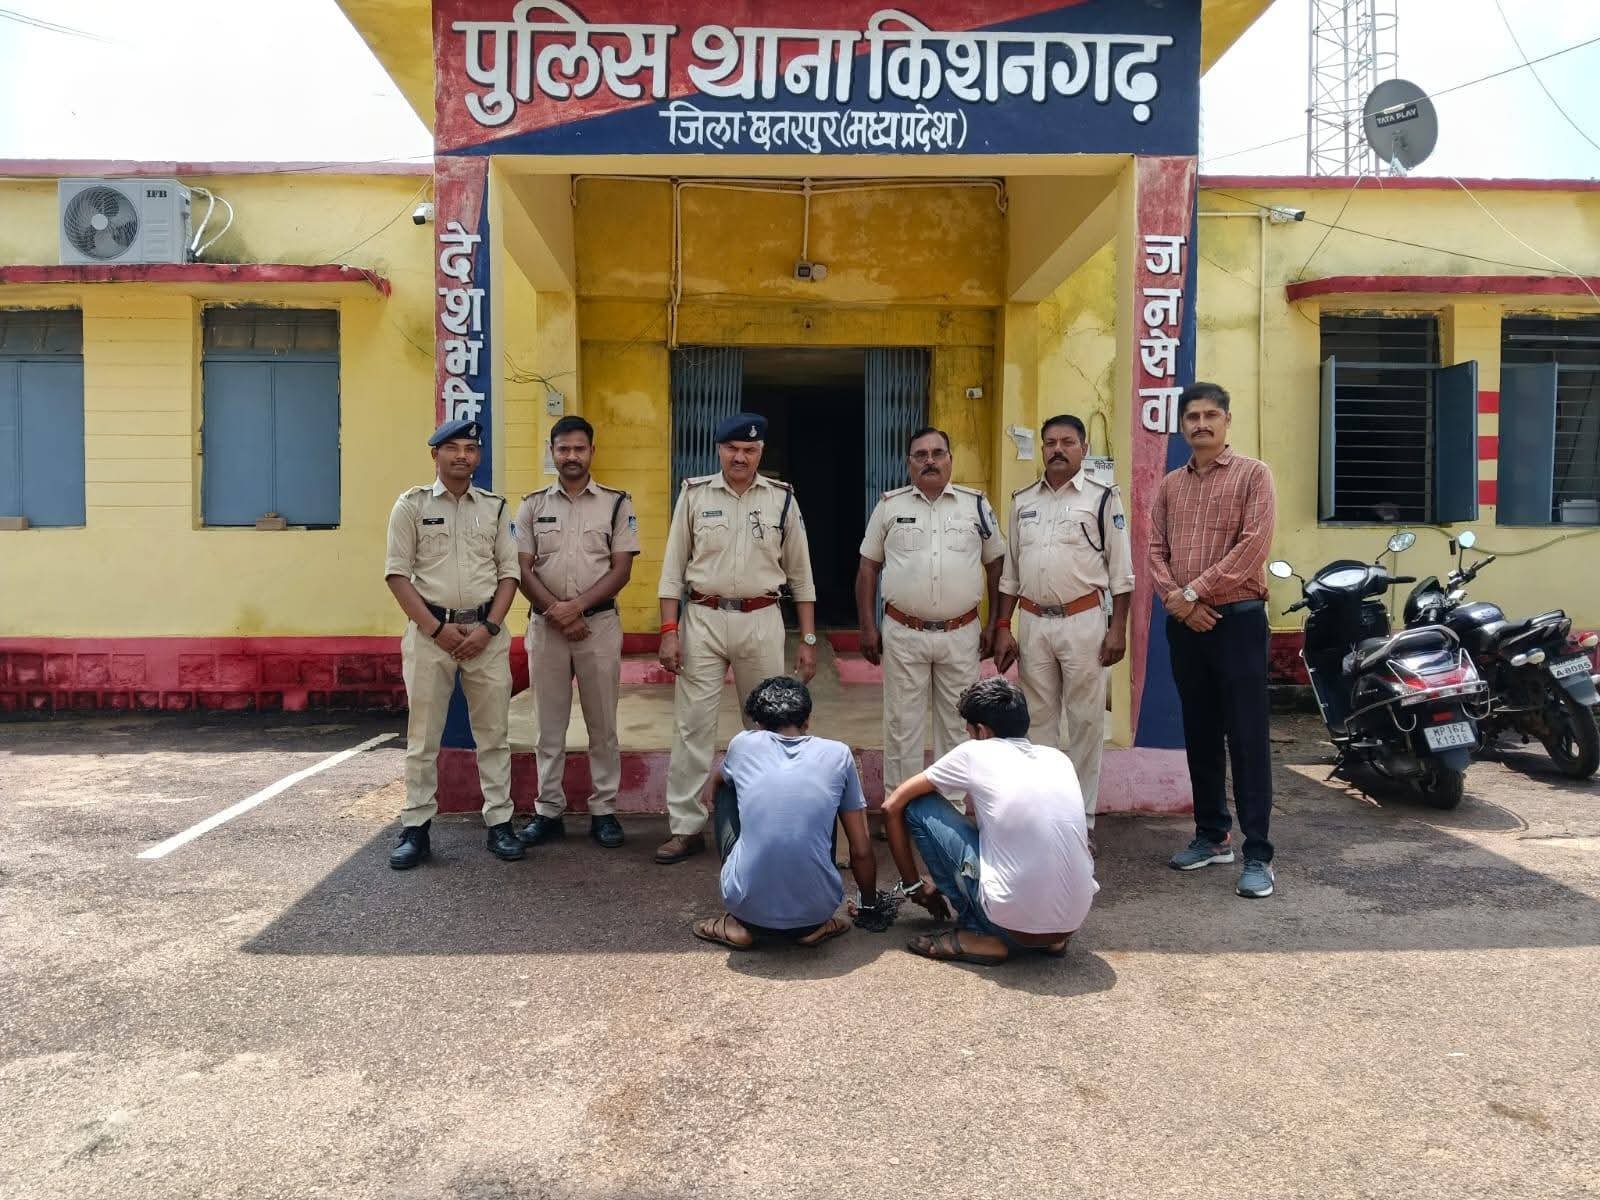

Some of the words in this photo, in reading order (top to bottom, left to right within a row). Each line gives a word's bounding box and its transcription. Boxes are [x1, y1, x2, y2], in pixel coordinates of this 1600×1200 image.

[452, 0, 678, 127] पुलिस
[687, 24, 863, 102] थाना
[864, 8, 1174, 123] किशनगढ़
[1377, 115, 1395, 125] TATA
[1396, 108, 1417, 119] PLAY
[146, 190, 168, 198] IFB
